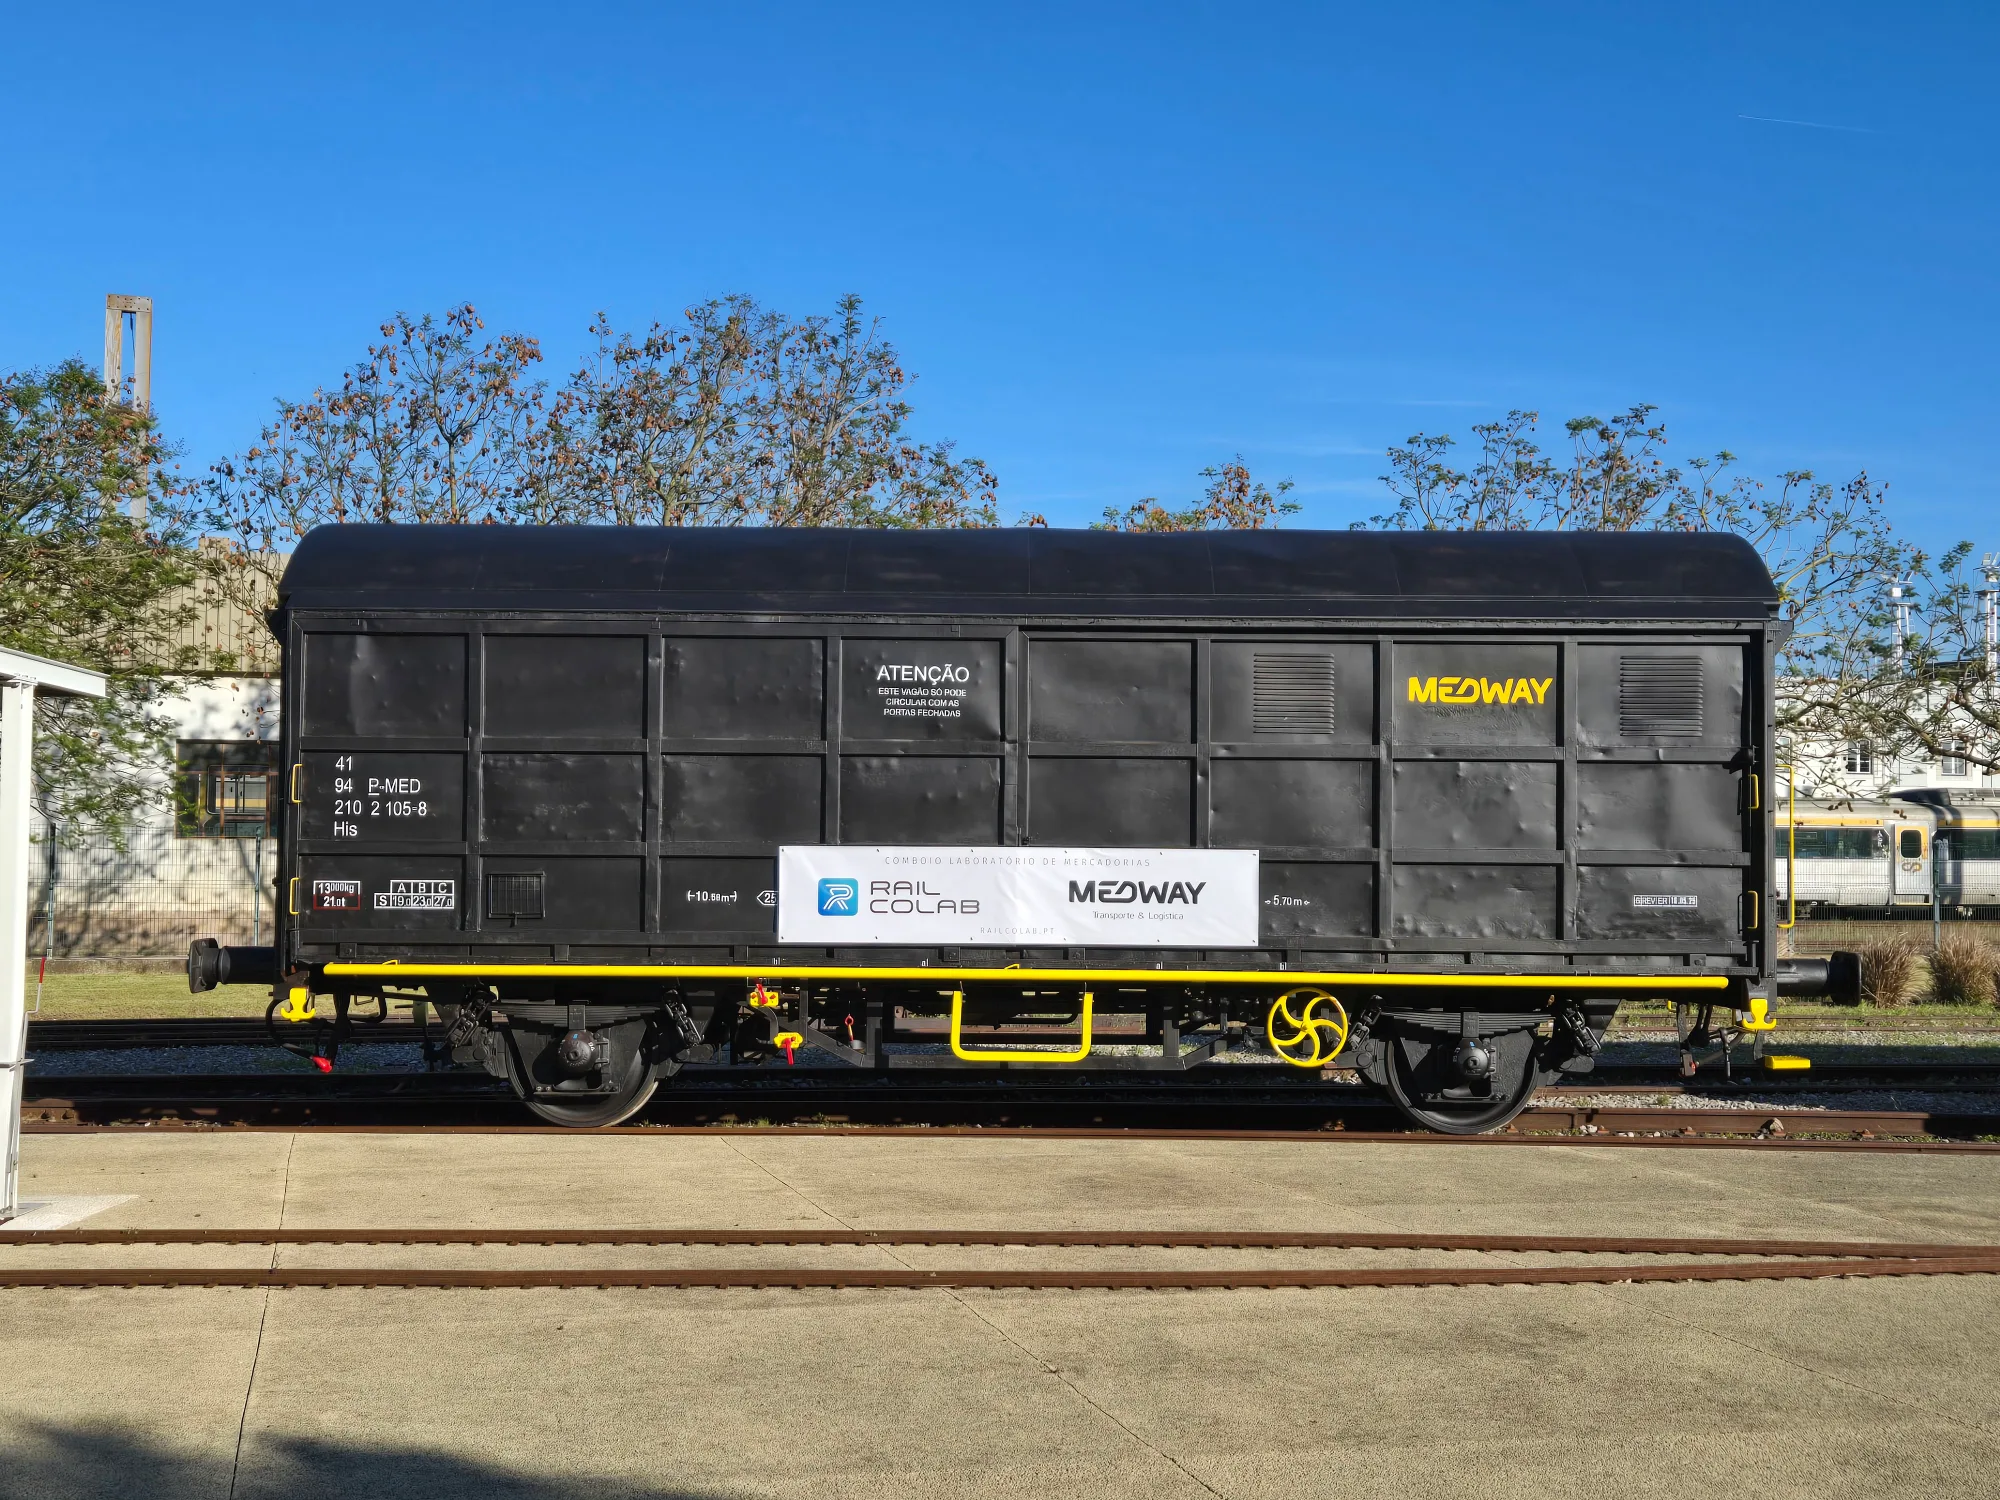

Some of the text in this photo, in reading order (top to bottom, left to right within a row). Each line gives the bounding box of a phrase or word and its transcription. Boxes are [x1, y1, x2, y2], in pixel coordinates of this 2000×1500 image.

[877, 663, 970, 686] ATENÇÃO
[930, 687, 942, 696] SÓ
[944, 688, 967, 697] PODE
[1408, 676, 1554, 704] MEDWAY
[885, 698, 960, 707] CIRCULAR COM AS
[883, 708, 961, 717] PORTAS FECHADAS
[335, 755, 352, 771] 41
[334, 777, 421, 796] 94 P-MED
[334, 799, 362, 815] 210
[370, 800, 380, 816] 2
[333, 820, 358, 836] His
[885, 855, 1151, 867] COMBOIO LABORATÓRIO DE MERCADORIAS
[397, 882, 448, 894] A B C
[870, 881, 941, 895] RAIL
[1068, 880, 1207, 904] MEDWAY
[379, 896, 388, 907] S
[869, 899, 980, 914] COLAB
[1093, 911, 1135, 920] Transporte
[980, 927, 1055, 935] RAILCOLAB.PT
